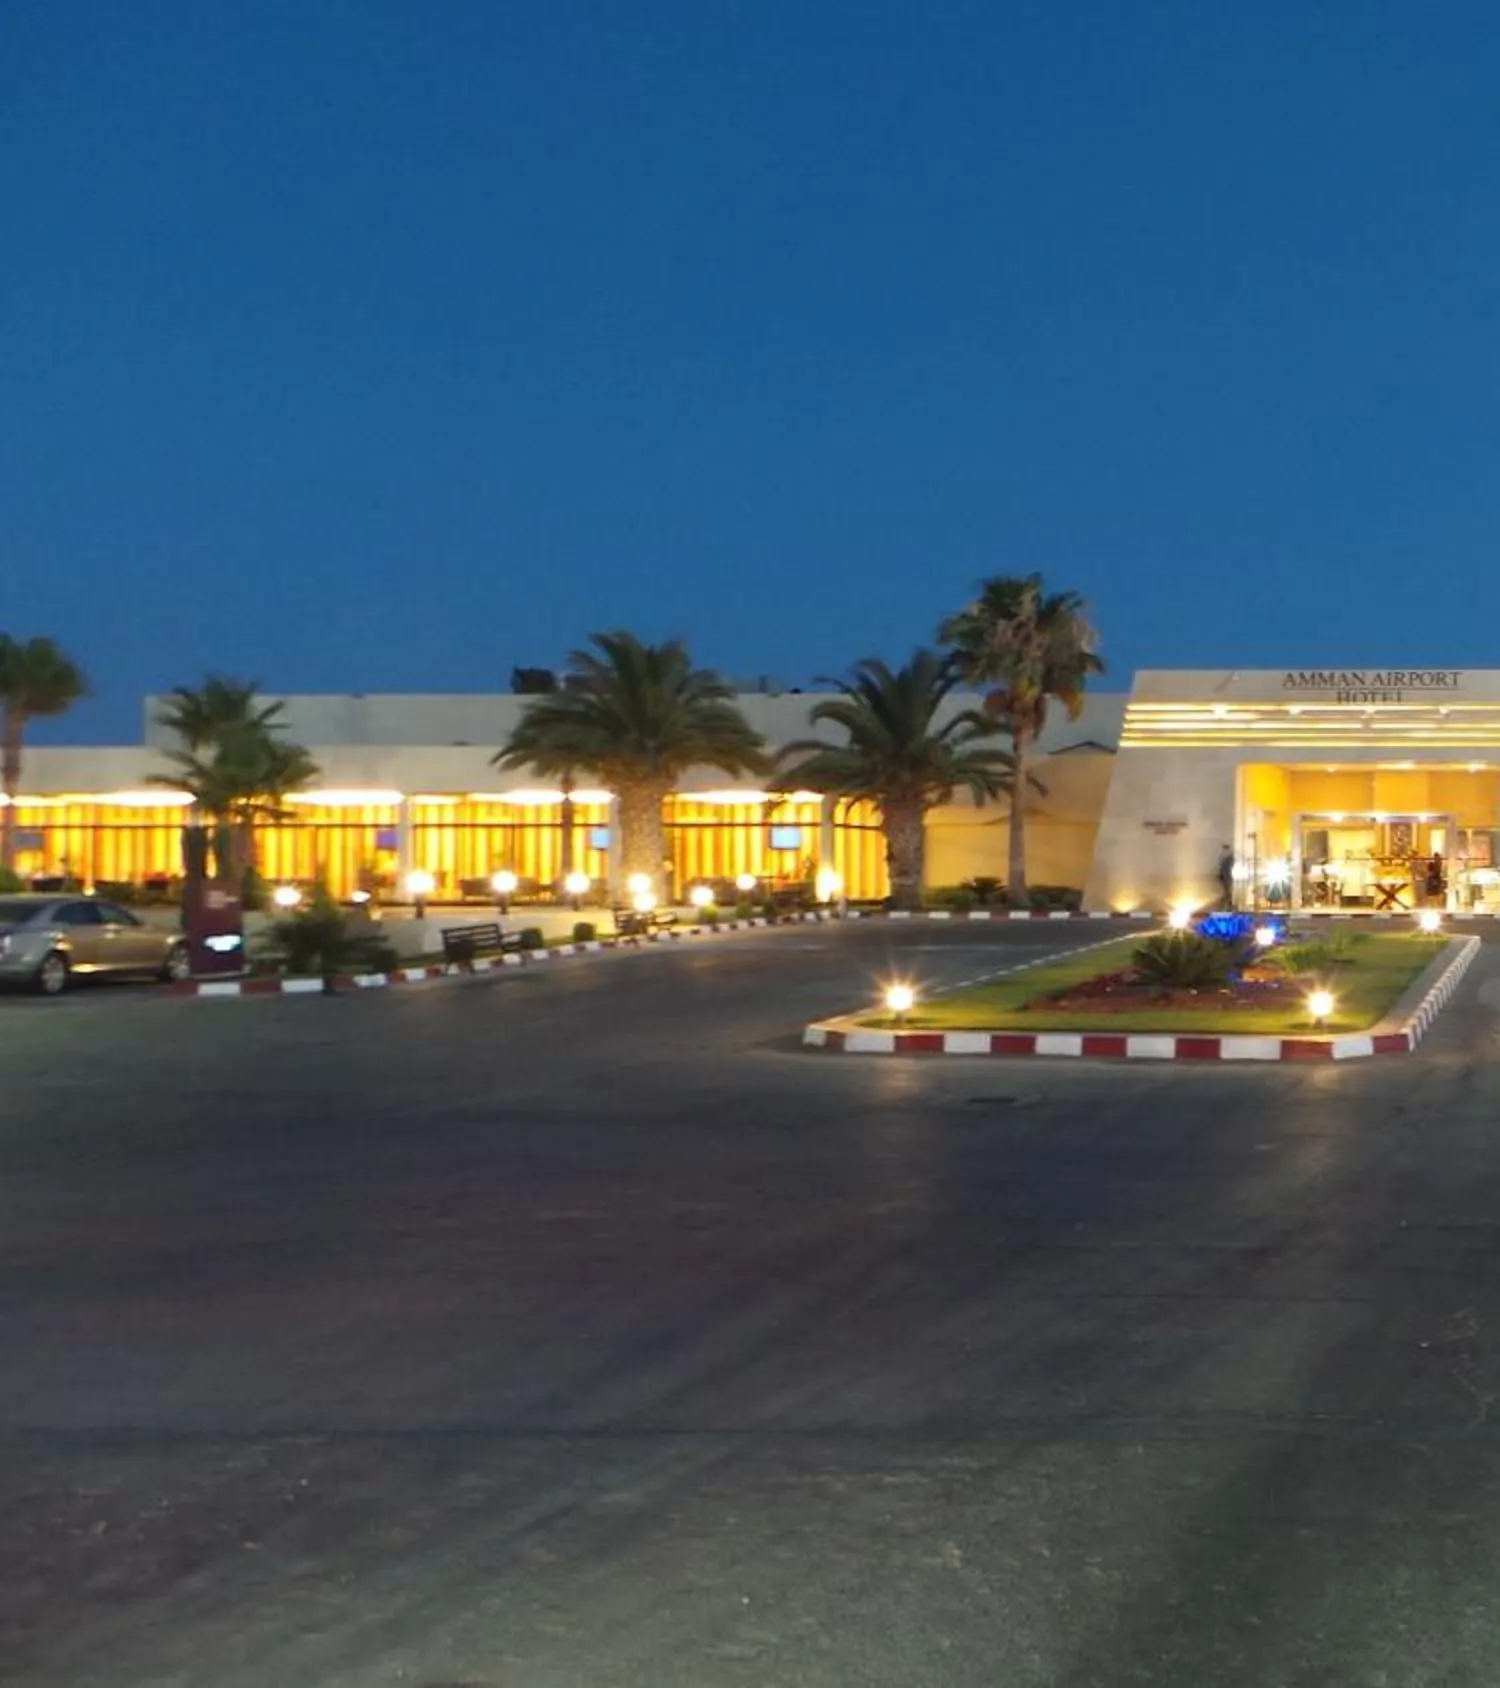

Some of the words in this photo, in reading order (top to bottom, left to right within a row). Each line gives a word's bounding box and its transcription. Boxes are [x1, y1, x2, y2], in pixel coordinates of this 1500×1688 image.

[1283, 671, 1366, 687] AMMAN
[1371, 671, 1463, 687] AIRPORT
[1336, 690, 1403, 705] HOTEL
